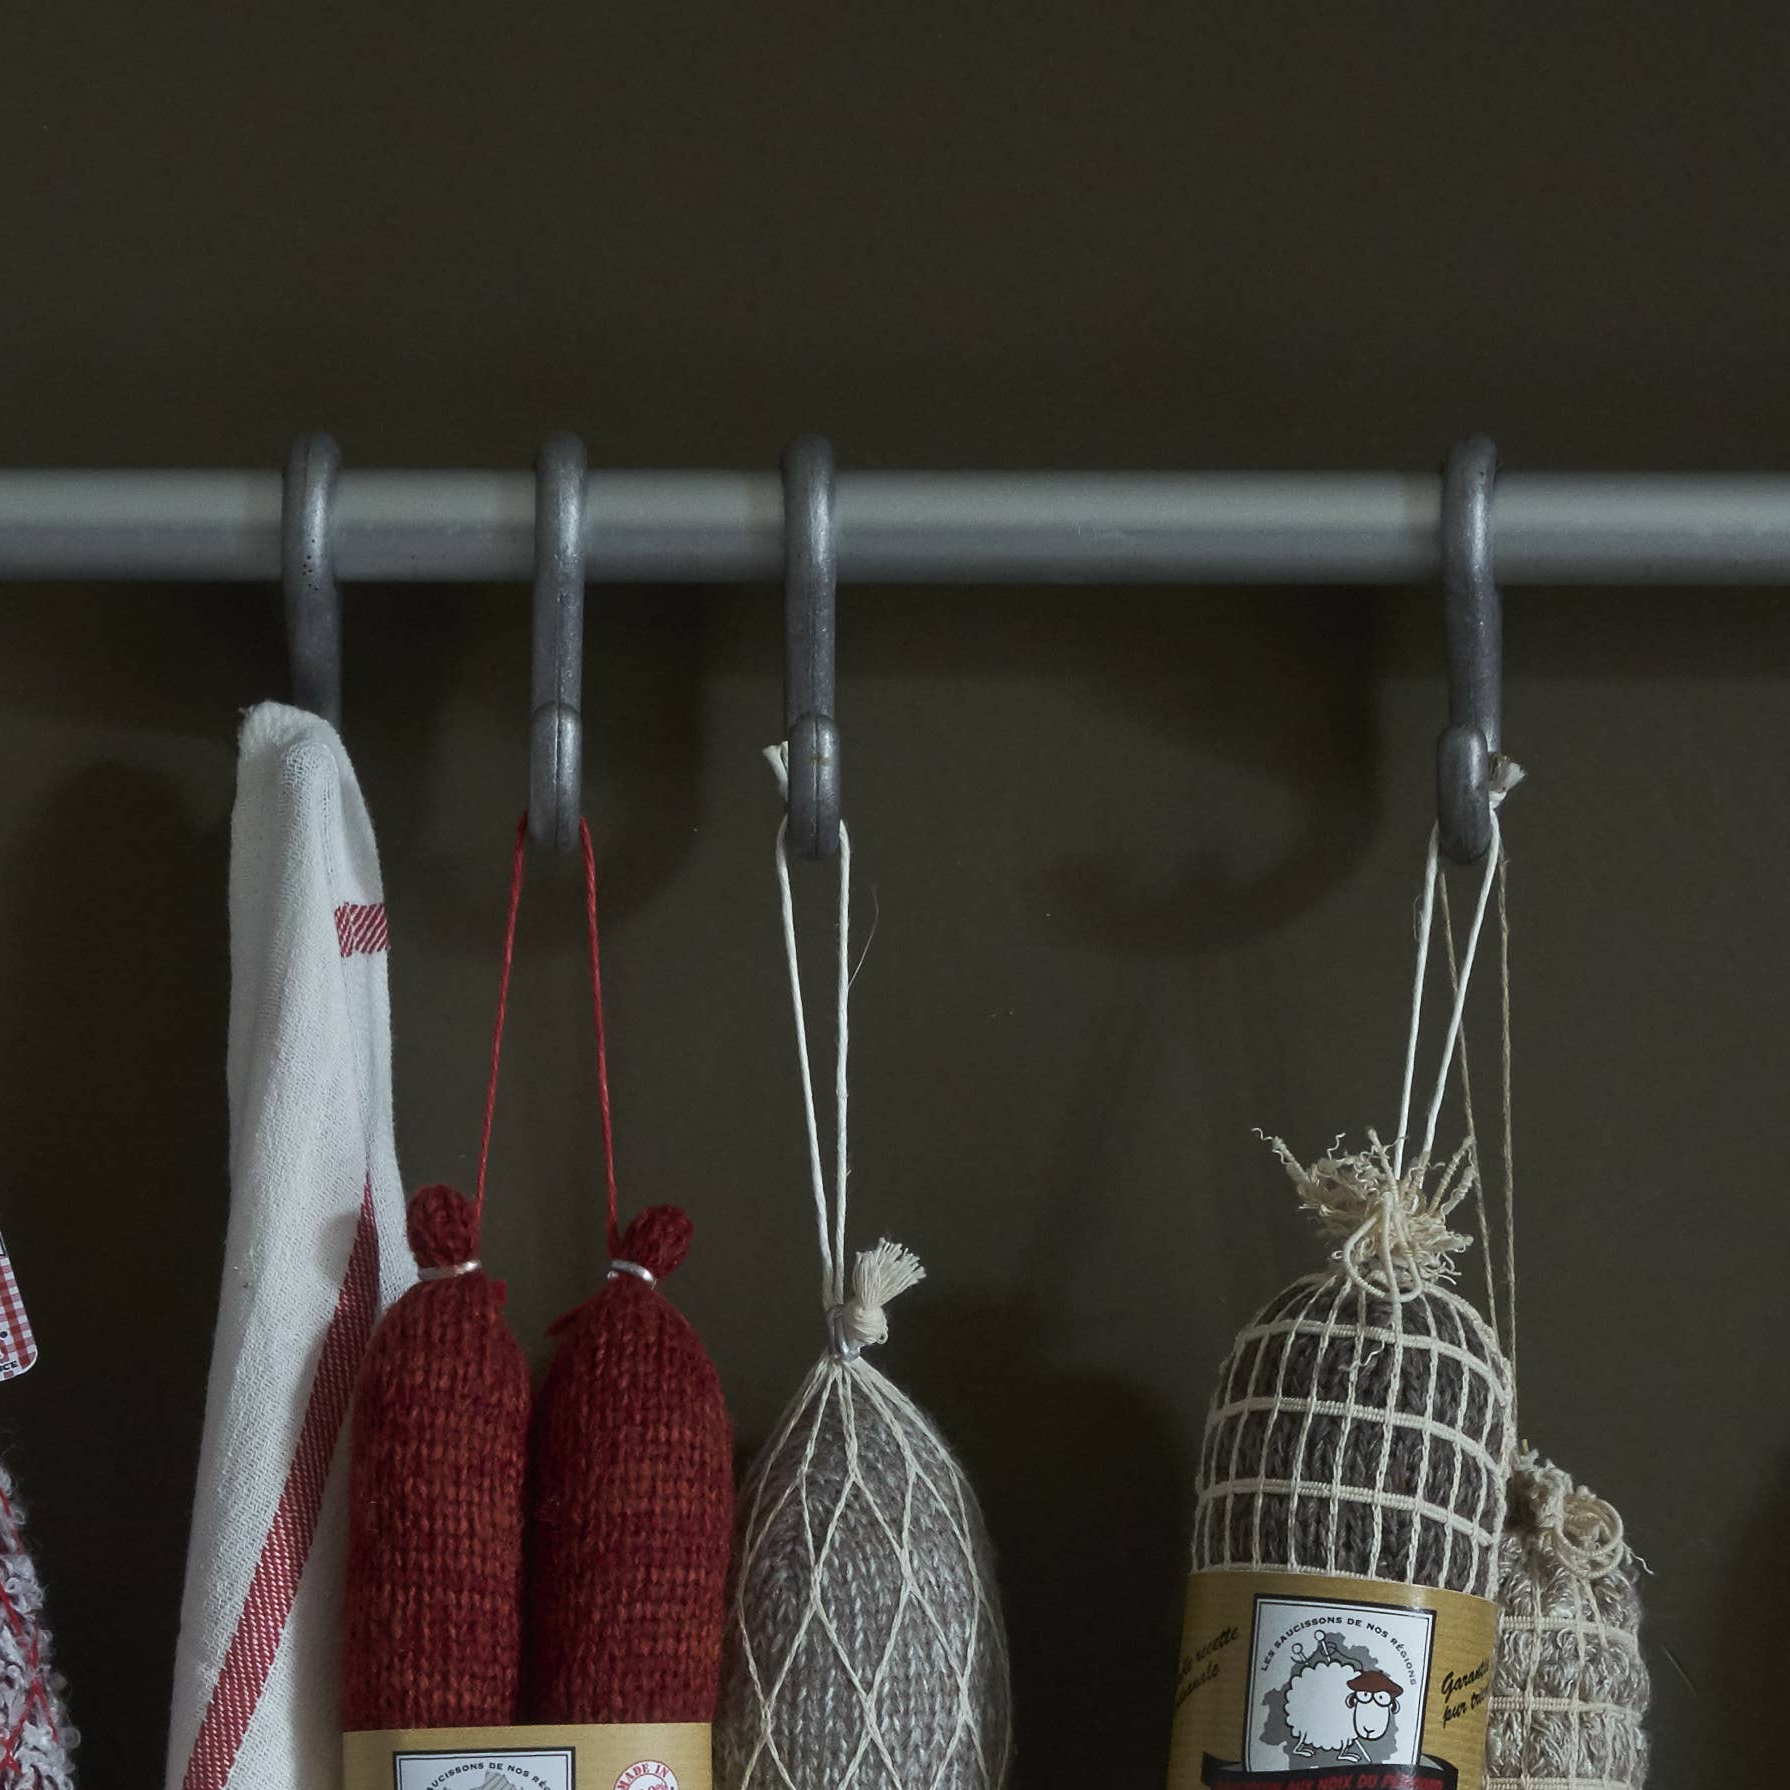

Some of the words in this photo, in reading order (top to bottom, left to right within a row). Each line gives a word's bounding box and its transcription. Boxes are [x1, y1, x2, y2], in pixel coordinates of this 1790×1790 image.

[1260, 1650, 1275, 1672] LES
[1273, 1615, 1343, 1649] SAUCISSONS
[1346, 1617, 1363, 1627] DE
[1365, 1622, 1390, 1638] NOS
[1389, 1637, 1418, 1687] RÉGIONS
[488, 1761, 504, 1771] DE
[507, 1764, 530, 1778] NOS
[654, 1763, 670, 1780] IN
